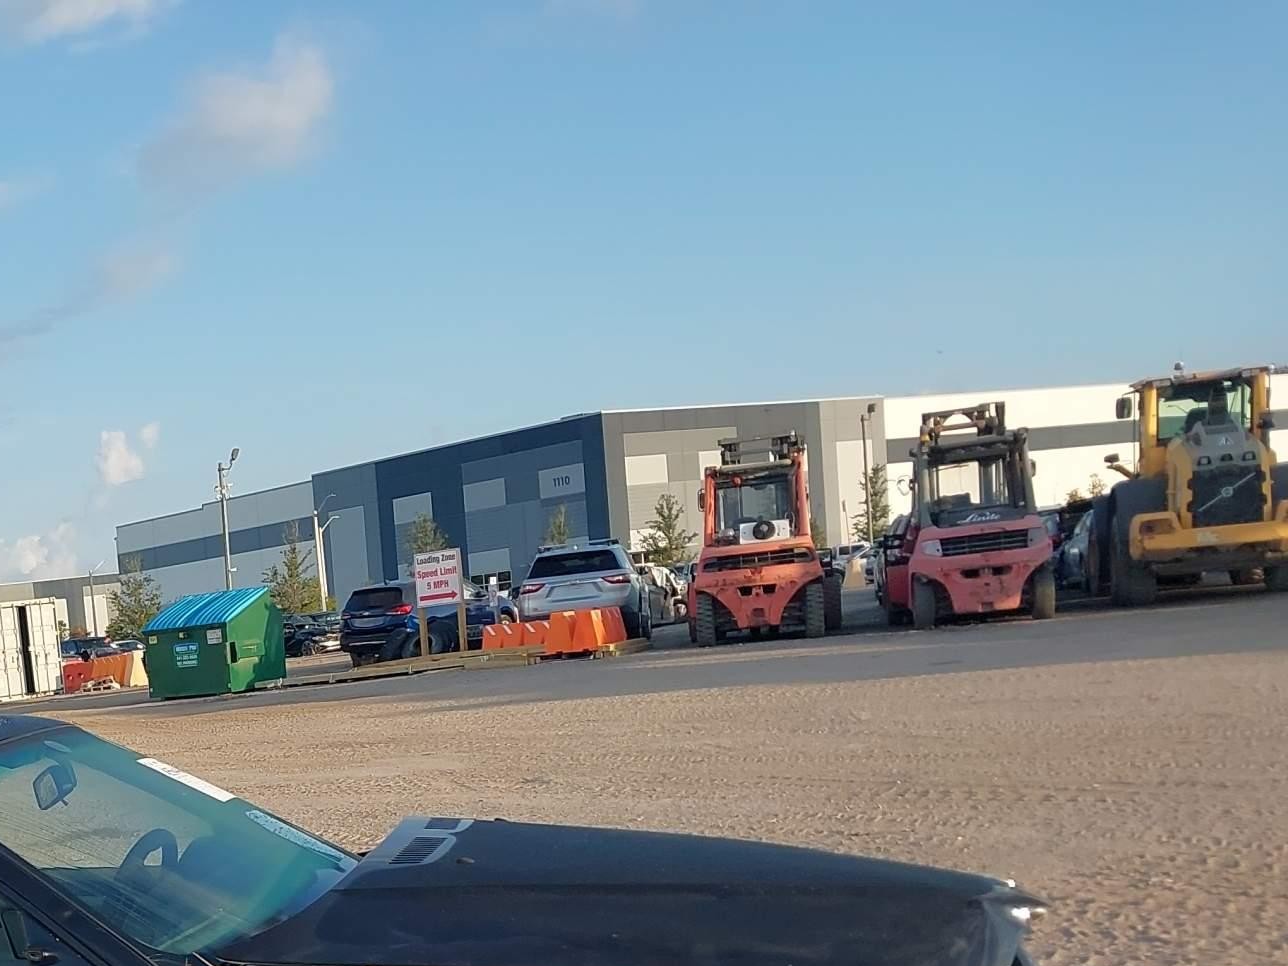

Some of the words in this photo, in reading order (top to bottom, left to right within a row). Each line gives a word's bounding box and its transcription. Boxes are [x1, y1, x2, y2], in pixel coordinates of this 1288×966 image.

[553, 475, 570, 488] 1110
[416, 555, 440, 565] Loading
[441, 553, 456, 562] Zone
[417, 568, 438, 580] Speed
[440, 566, 456, 575] Limit
[426, 581, 432, 590] 5
[433, 579, 449, 589] MPH
